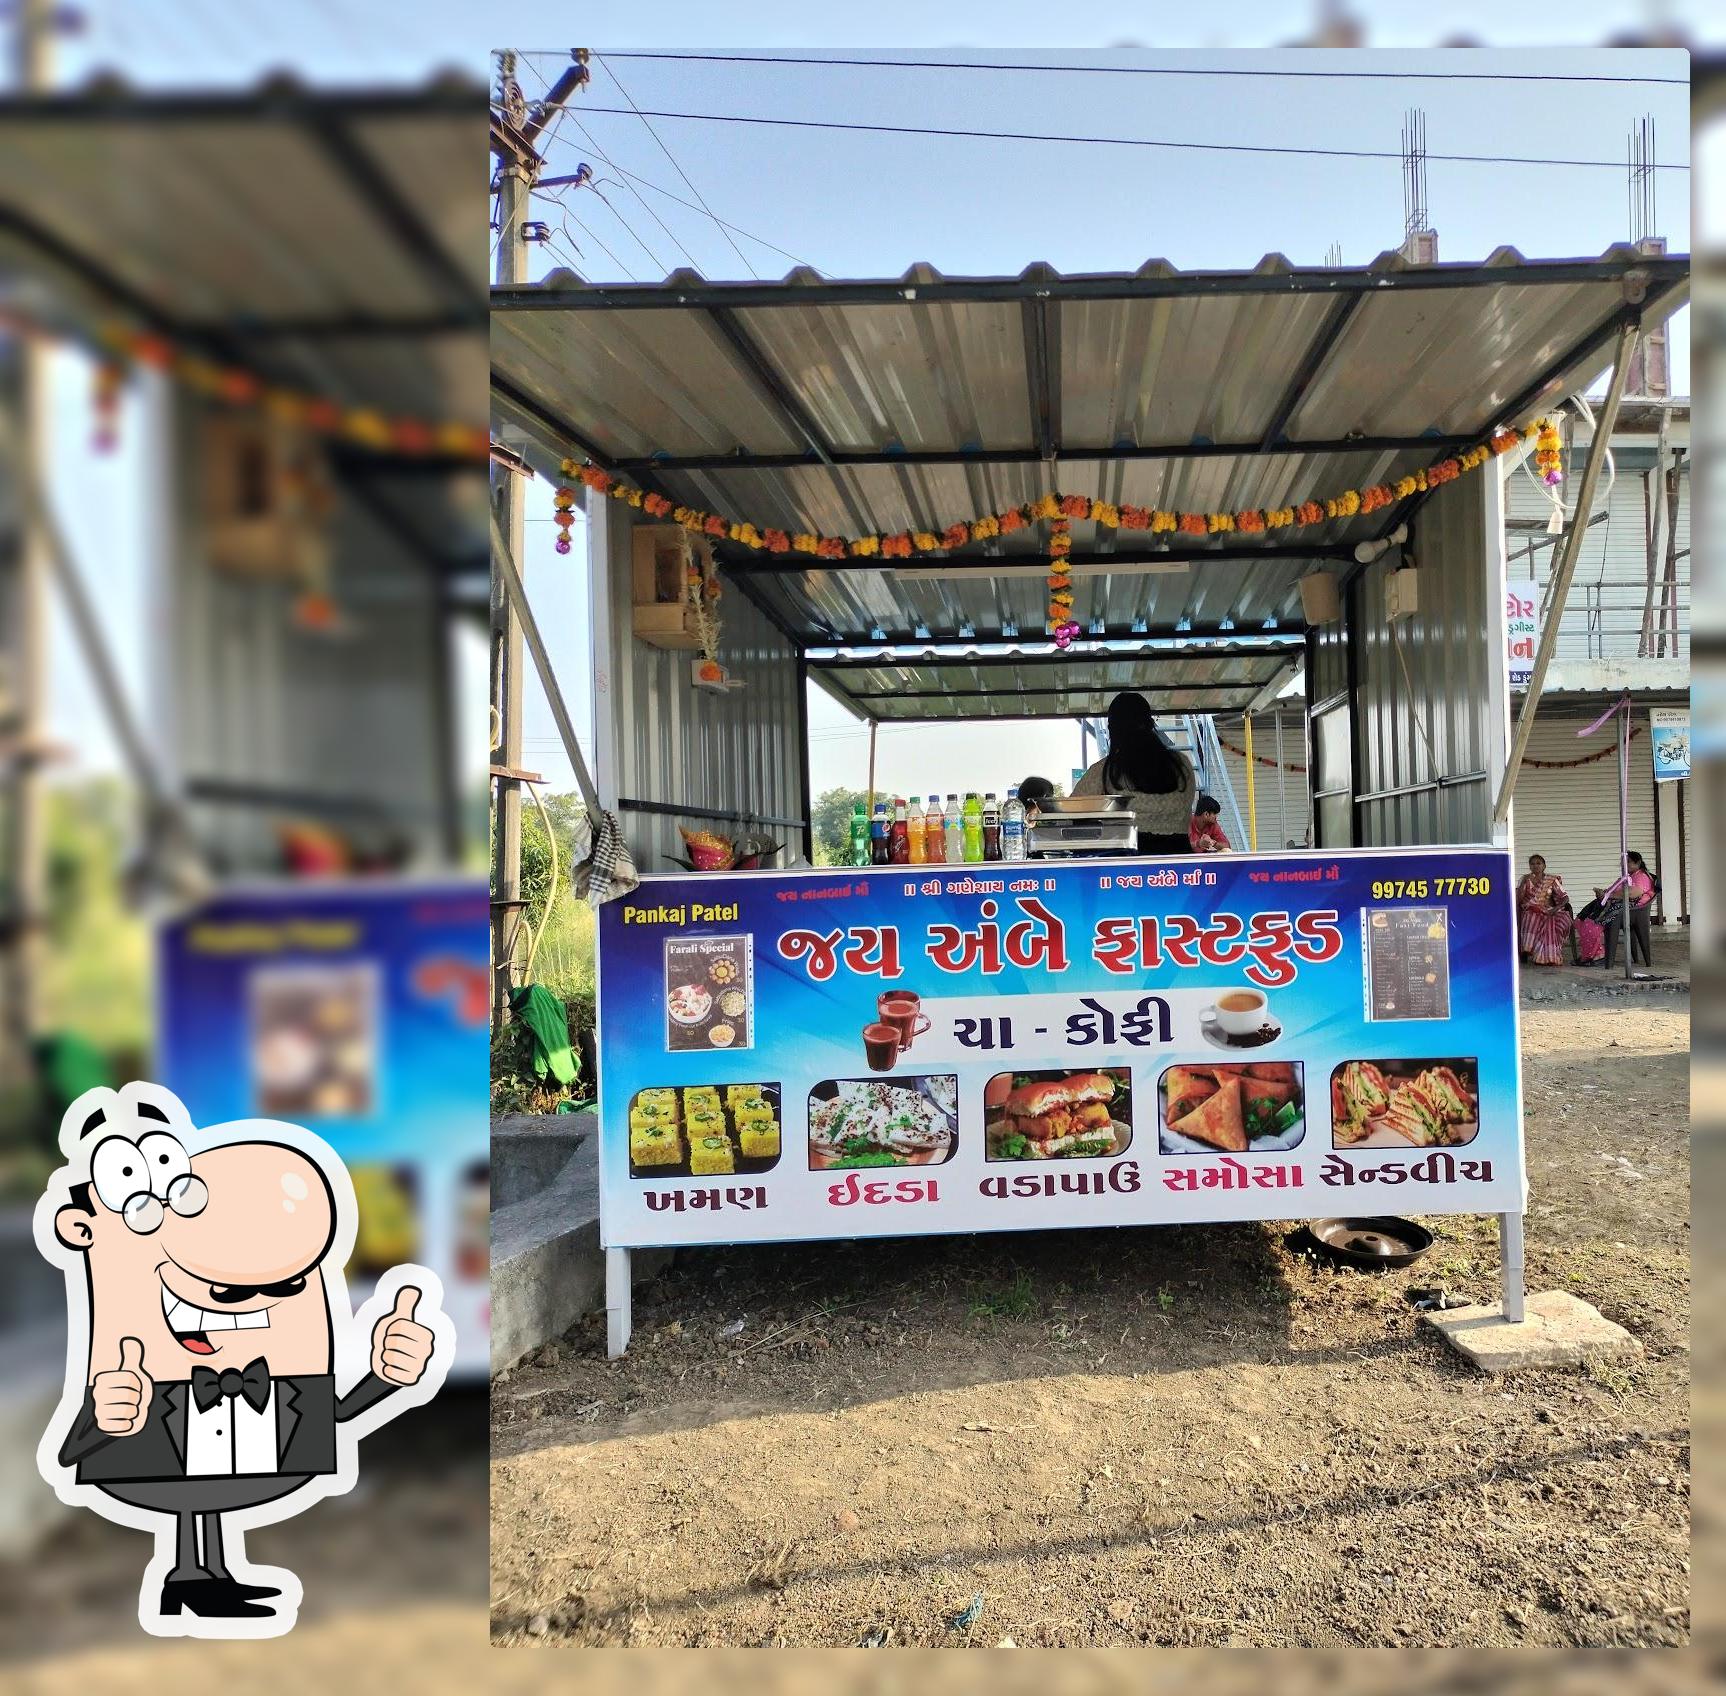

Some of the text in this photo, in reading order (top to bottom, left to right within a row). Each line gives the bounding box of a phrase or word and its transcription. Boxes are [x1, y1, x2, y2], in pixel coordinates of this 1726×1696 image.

[921, 879, 942, 896] શ્રી
[946, 877, 1005, 894] ગણેશાય
[1116, 876, 1142, 888] જય
[1148, 869, 1178, 887] અંબે
[1371, 876, 1491, 899] 99745 77730
[624, 903, 738, 926] Pankaj Patel
[670, 942, 734, 955] Farali Special
[777, 926, 904, 981] જય
[926, 898, 1071, 975] અંબે
[953, 1017, 1015, 1050] ચા
[1065, 996, 1174, 1046] કોફી
[1163, 1157, 1304, 1191] સમોસા
[1319, 1152, 1494, 1186] સેન્ડવીચ
[643, 1186, 768, 1212] ખમણ
[827, 1173, 942, 1206] ઈદડા
